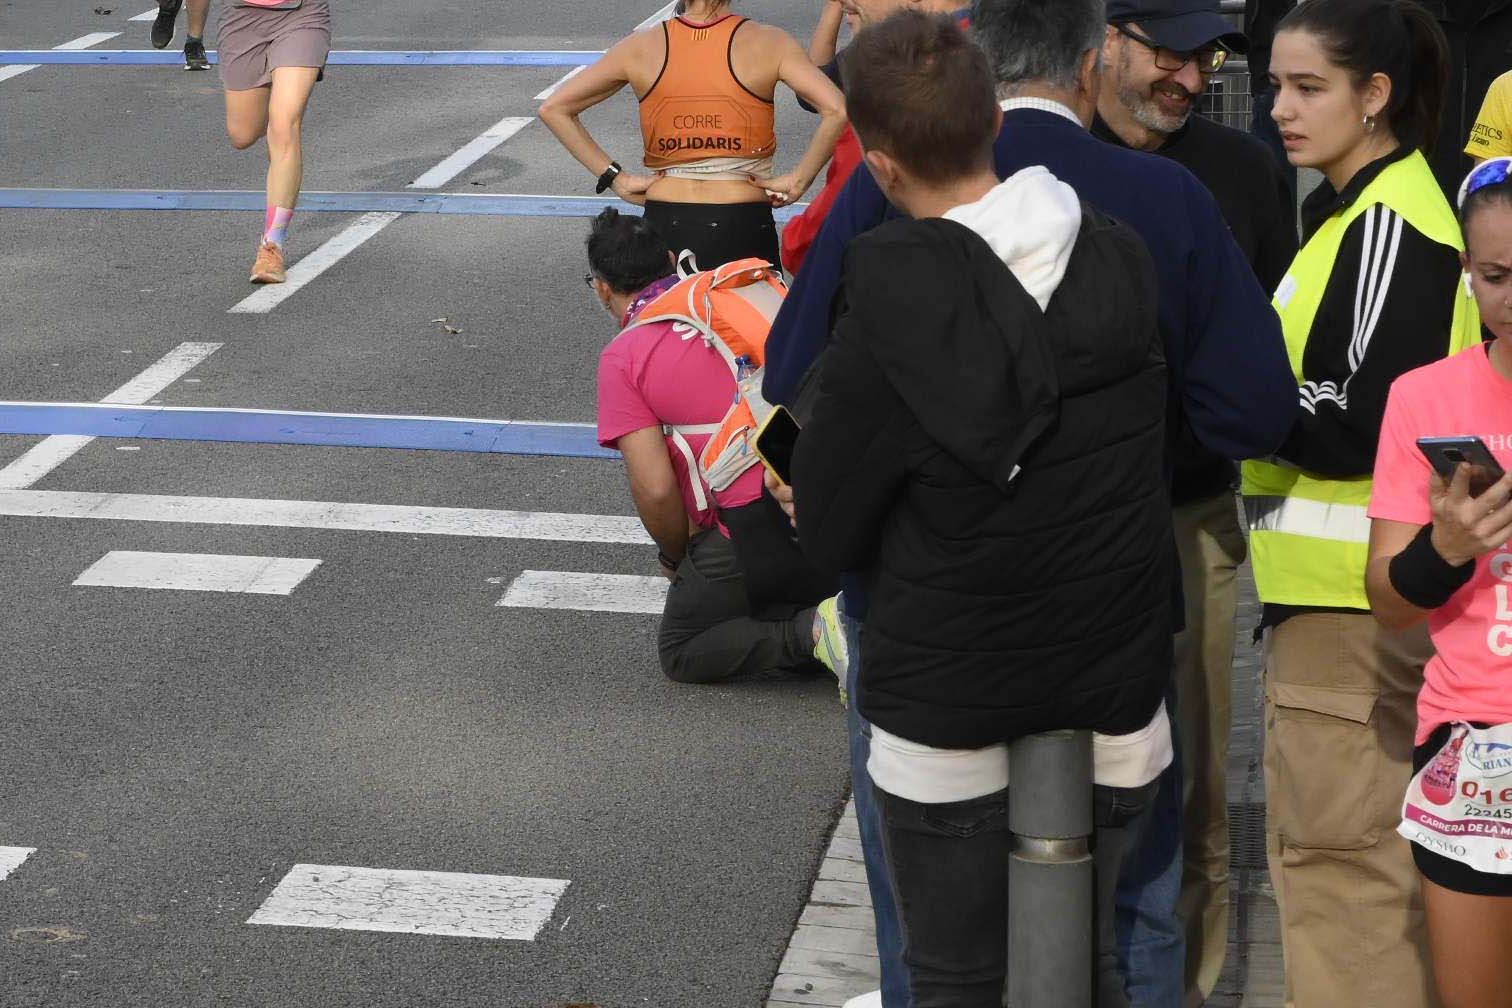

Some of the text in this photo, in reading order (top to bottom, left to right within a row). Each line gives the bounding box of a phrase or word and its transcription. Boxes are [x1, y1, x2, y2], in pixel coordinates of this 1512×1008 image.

[673, 114, 722, 130] CORRE
[1473, 123, 1502, 141] ETICS
[658, 137, 742, 152] SOLIDARIS
[1468, 823, 1483, 832] DE
[1485, 824, 1497, 833] LA
